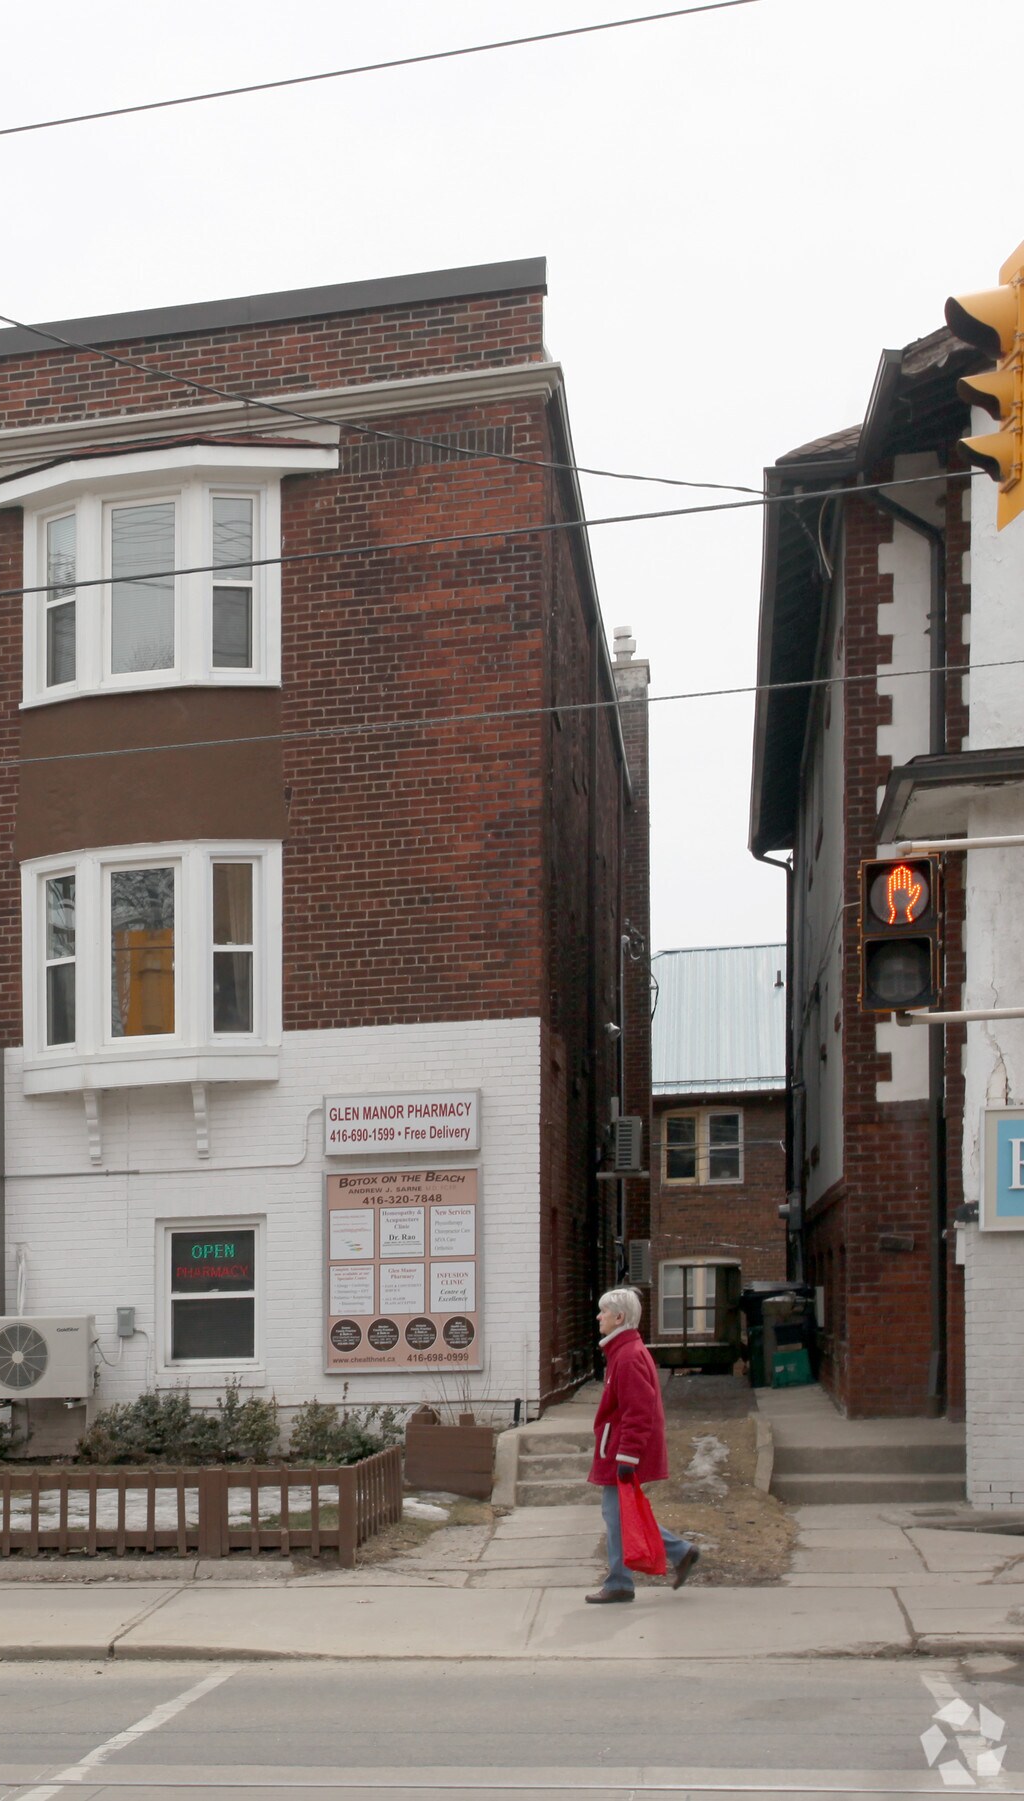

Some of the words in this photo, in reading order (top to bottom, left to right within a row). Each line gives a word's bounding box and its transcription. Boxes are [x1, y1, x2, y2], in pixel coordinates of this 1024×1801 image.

[329, 1107, 360, 1122] GLEN
[362, 1104, 404, 1120] MANOR
[407, 1102, 472, 1118] PHARMACY
[330, 1128, 395, 1142] 416-690-1599
[404, 1127, 426, 1140] Free
[429, 1125, 471, 1142] Delivery
[381, 1175, 398, 1184] ON
[400, 1174, 422, 1183] THE
[362, 1194, 442, 1205] 416-320-7848
[191, 1244, 235, 1259] OPEN
[176, 1264, 249, 1278] PHARMACY
[407, 1353, 469, 1362] 416-698-0999
